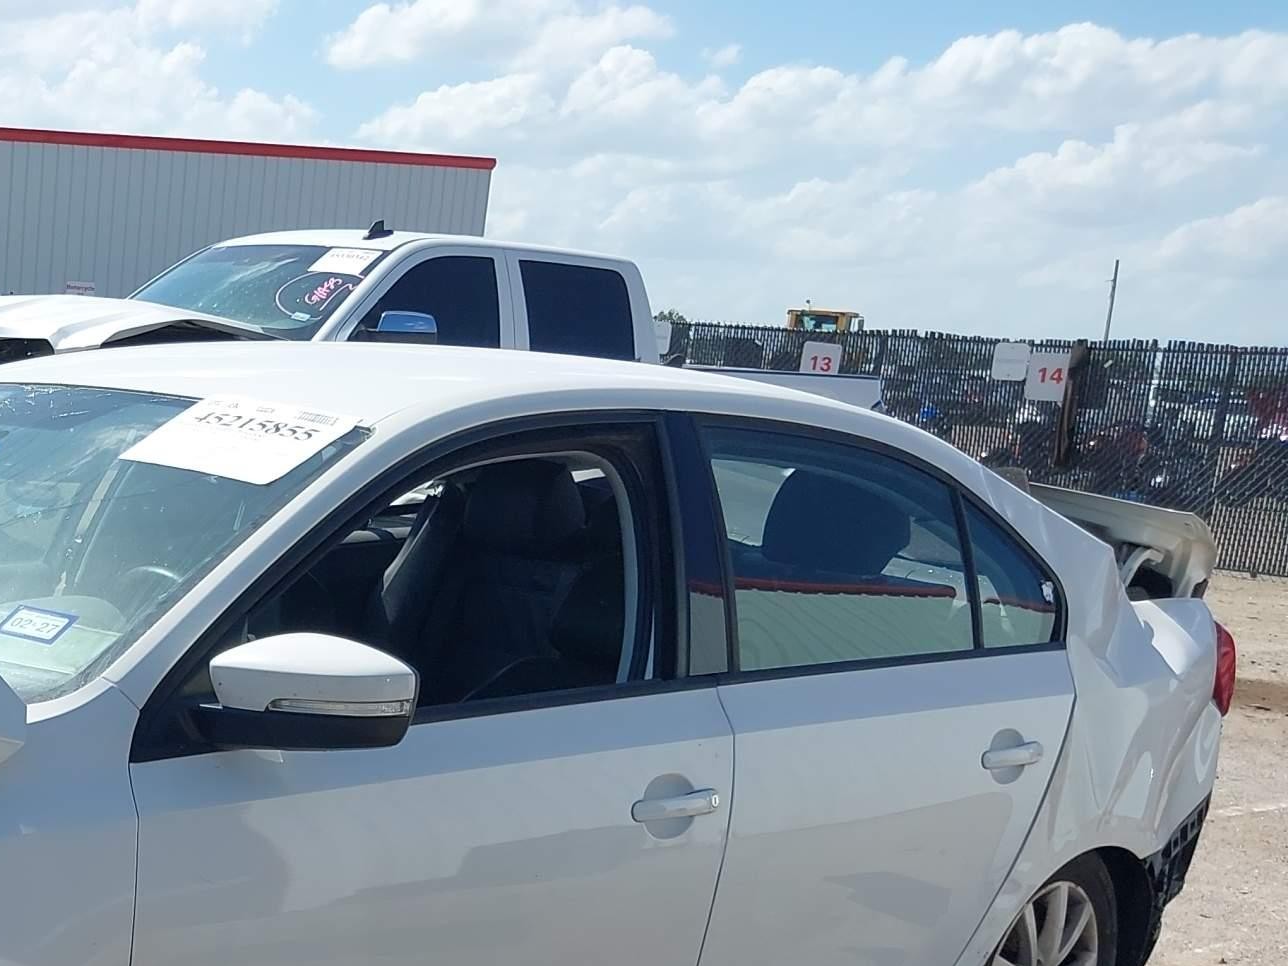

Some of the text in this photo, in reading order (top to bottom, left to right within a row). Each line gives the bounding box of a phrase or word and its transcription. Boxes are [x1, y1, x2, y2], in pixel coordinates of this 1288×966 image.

[809, 354, 832, 373] 13
[1037, 367, 1064, 385] 14
[193, 410, 322, 442] 45215855
